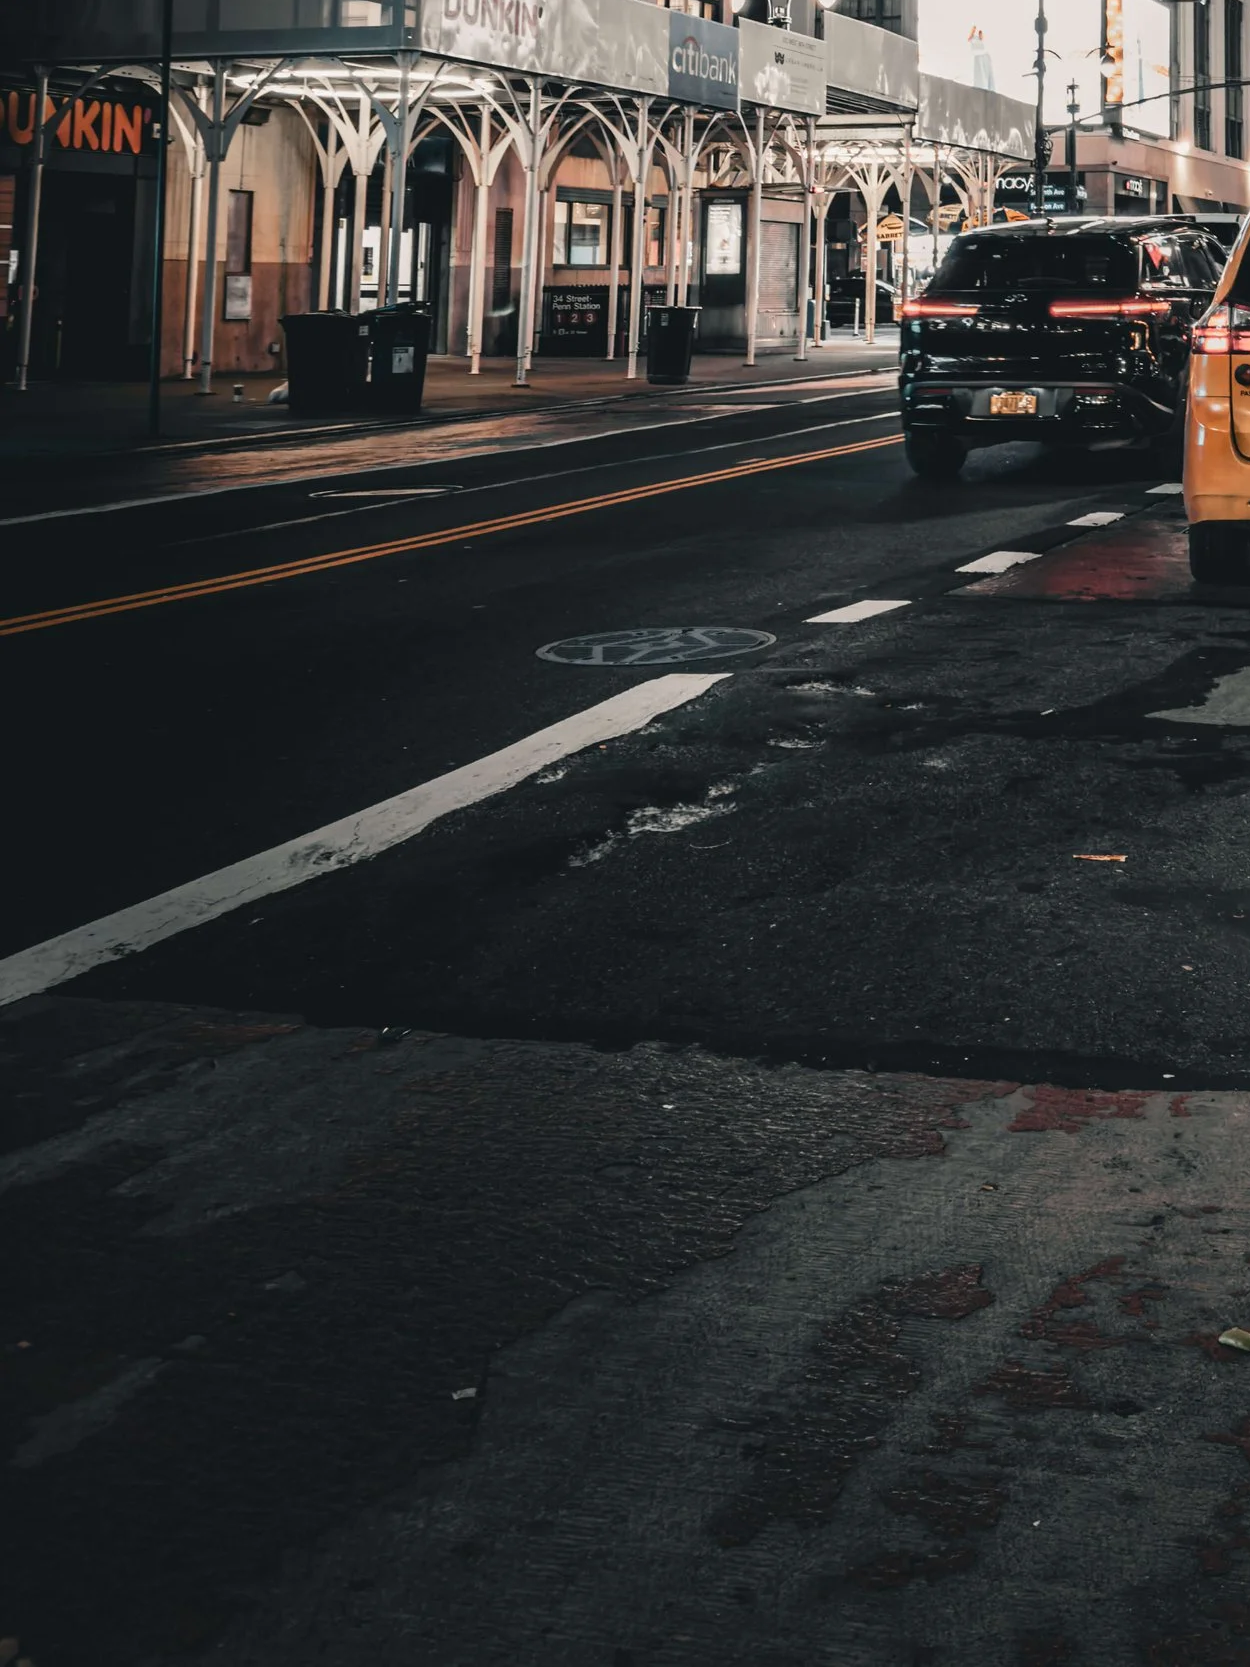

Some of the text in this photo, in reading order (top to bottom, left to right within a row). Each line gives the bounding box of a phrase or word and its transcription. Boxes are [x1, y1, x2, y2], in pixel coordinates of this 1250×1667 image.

[672, 40, 737, 85] citibank
[0, 91, 152, 154] UNKIN'
[1053, 188, 1065, 196] Ave
[553, 295, 563, 303] 34
[571, 315, 578, 323] 2
[586, 314, 593, 323] 3
